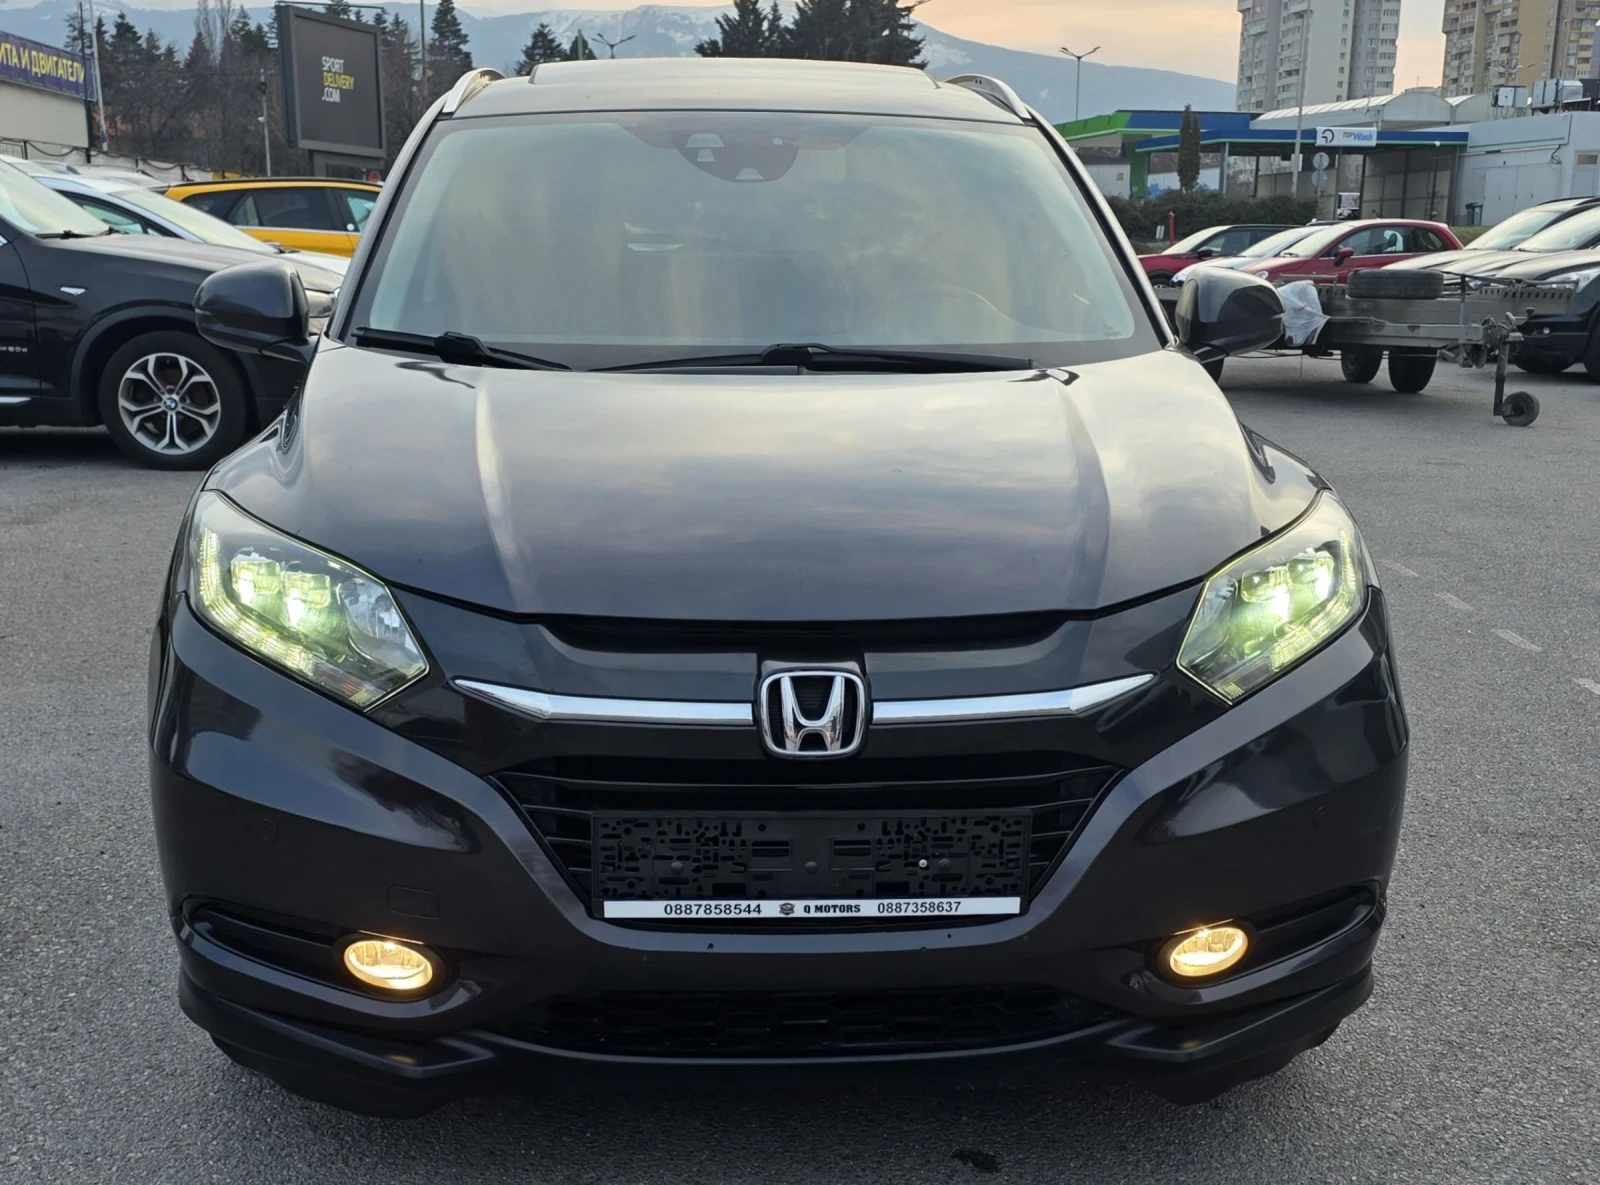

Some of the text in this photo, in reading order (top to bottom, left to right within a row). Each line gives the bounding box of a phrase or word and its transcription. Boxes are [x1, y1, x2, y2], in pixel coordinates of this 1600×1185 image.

[20, 47, 30, 71] И
[31, 50, 84, 84] ДВИГАТЕЛИ
[321, 55, 344, 73] SPORT
[323, 71, 354, 90] DELIVERY
[321, 87, 340, 103] .COM
[664, 901, 962, 916] 0887858544 Q MOTORS 0887358637
